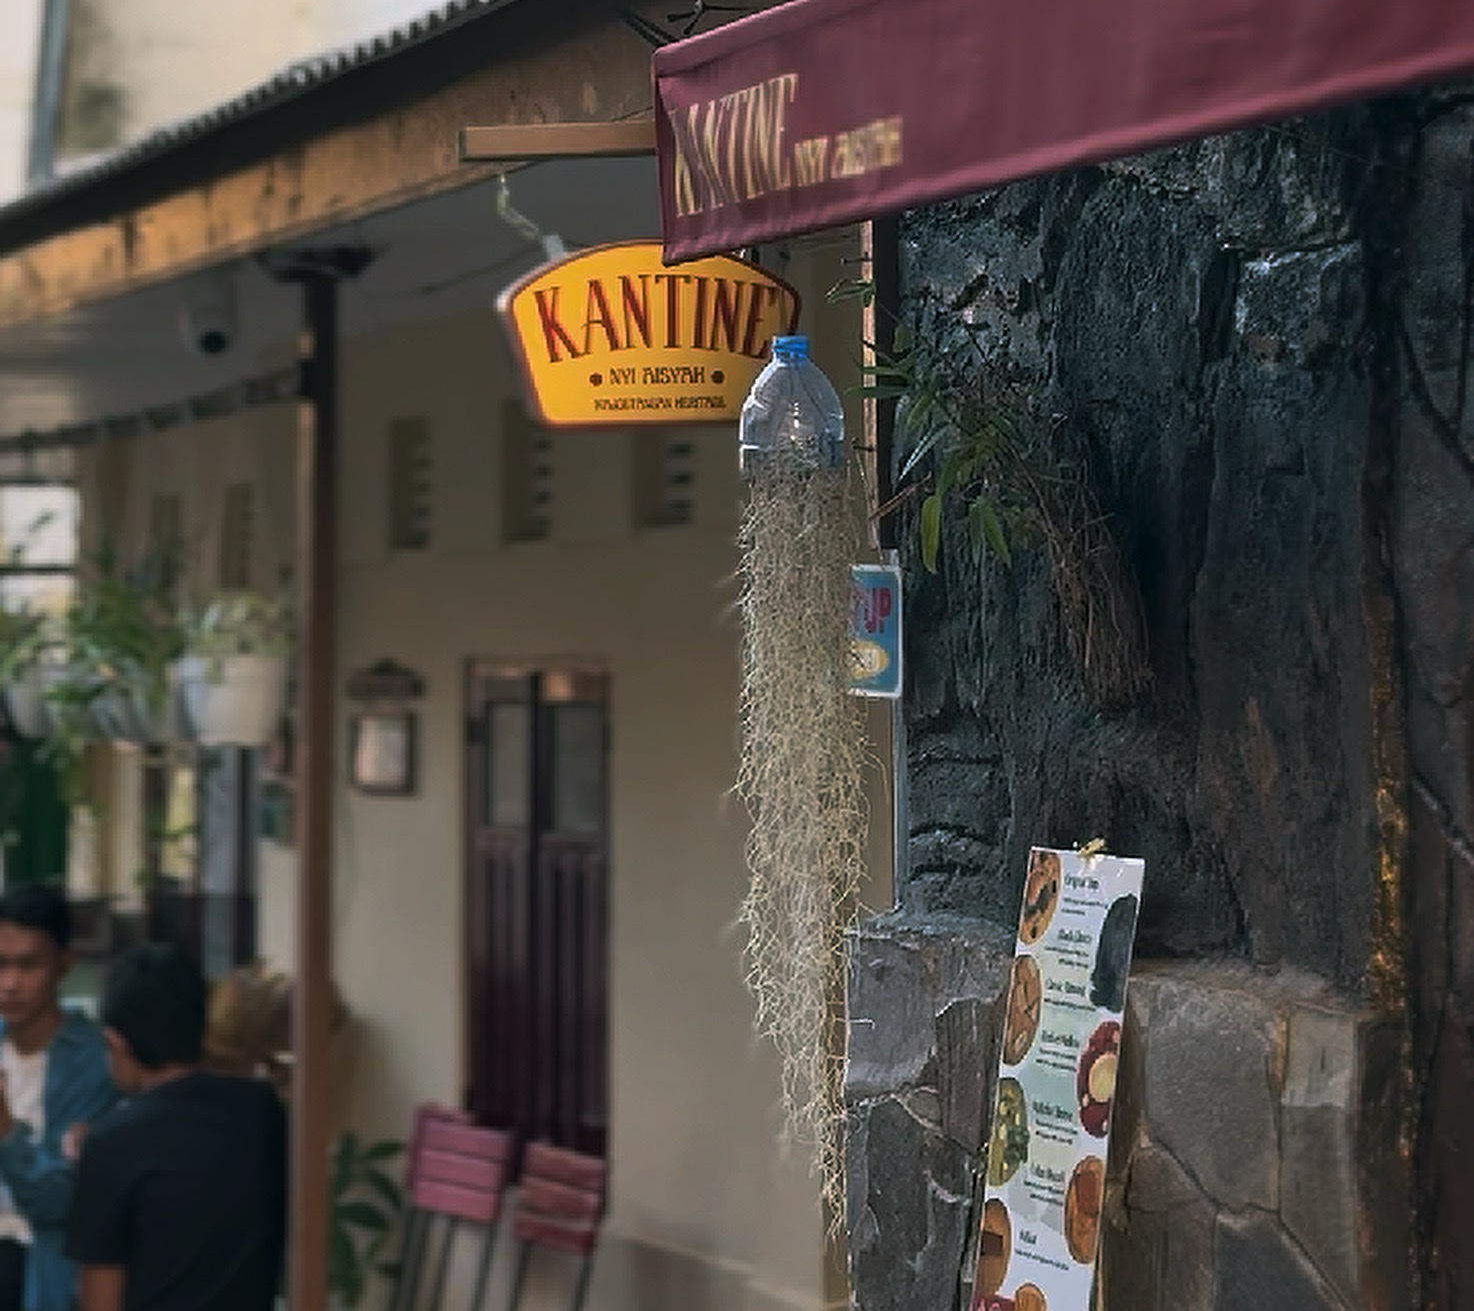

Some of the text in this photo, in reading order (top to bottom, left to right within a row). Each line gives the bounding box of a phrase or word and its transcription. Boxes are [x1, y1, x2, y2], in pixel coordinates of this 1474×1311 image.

[534, 274, 777, 363] KANTINE
[610, 366, 706, 386] NYI AISYAH
